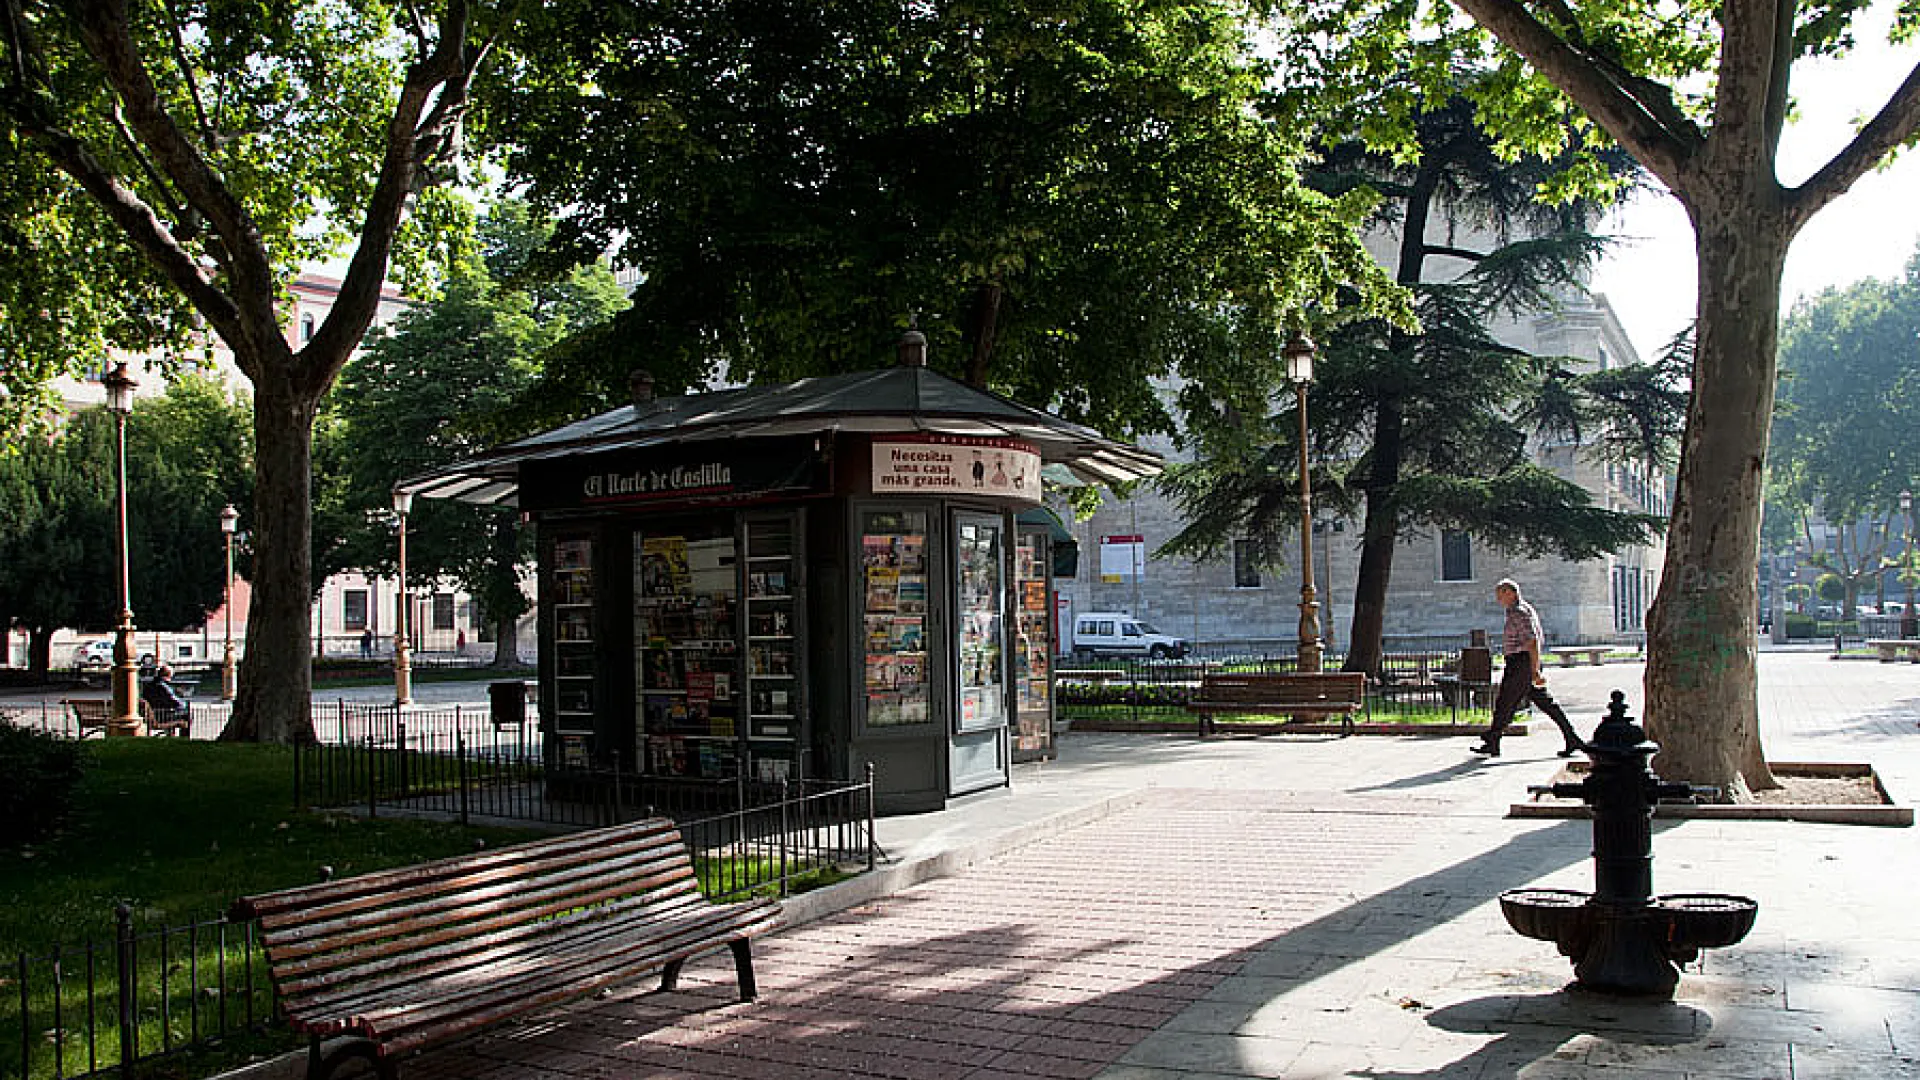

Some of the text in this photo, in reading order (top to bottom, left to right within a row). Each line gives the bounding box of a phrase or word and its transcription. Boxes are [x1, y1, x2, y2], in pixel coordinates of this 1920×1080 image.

[891, 449, 952, 462] Necesitas
[893, 464, 950, 474] una casa
[584, 462, 731, 496] El Norte de Castilla
[881, 474, 910, 485] más
